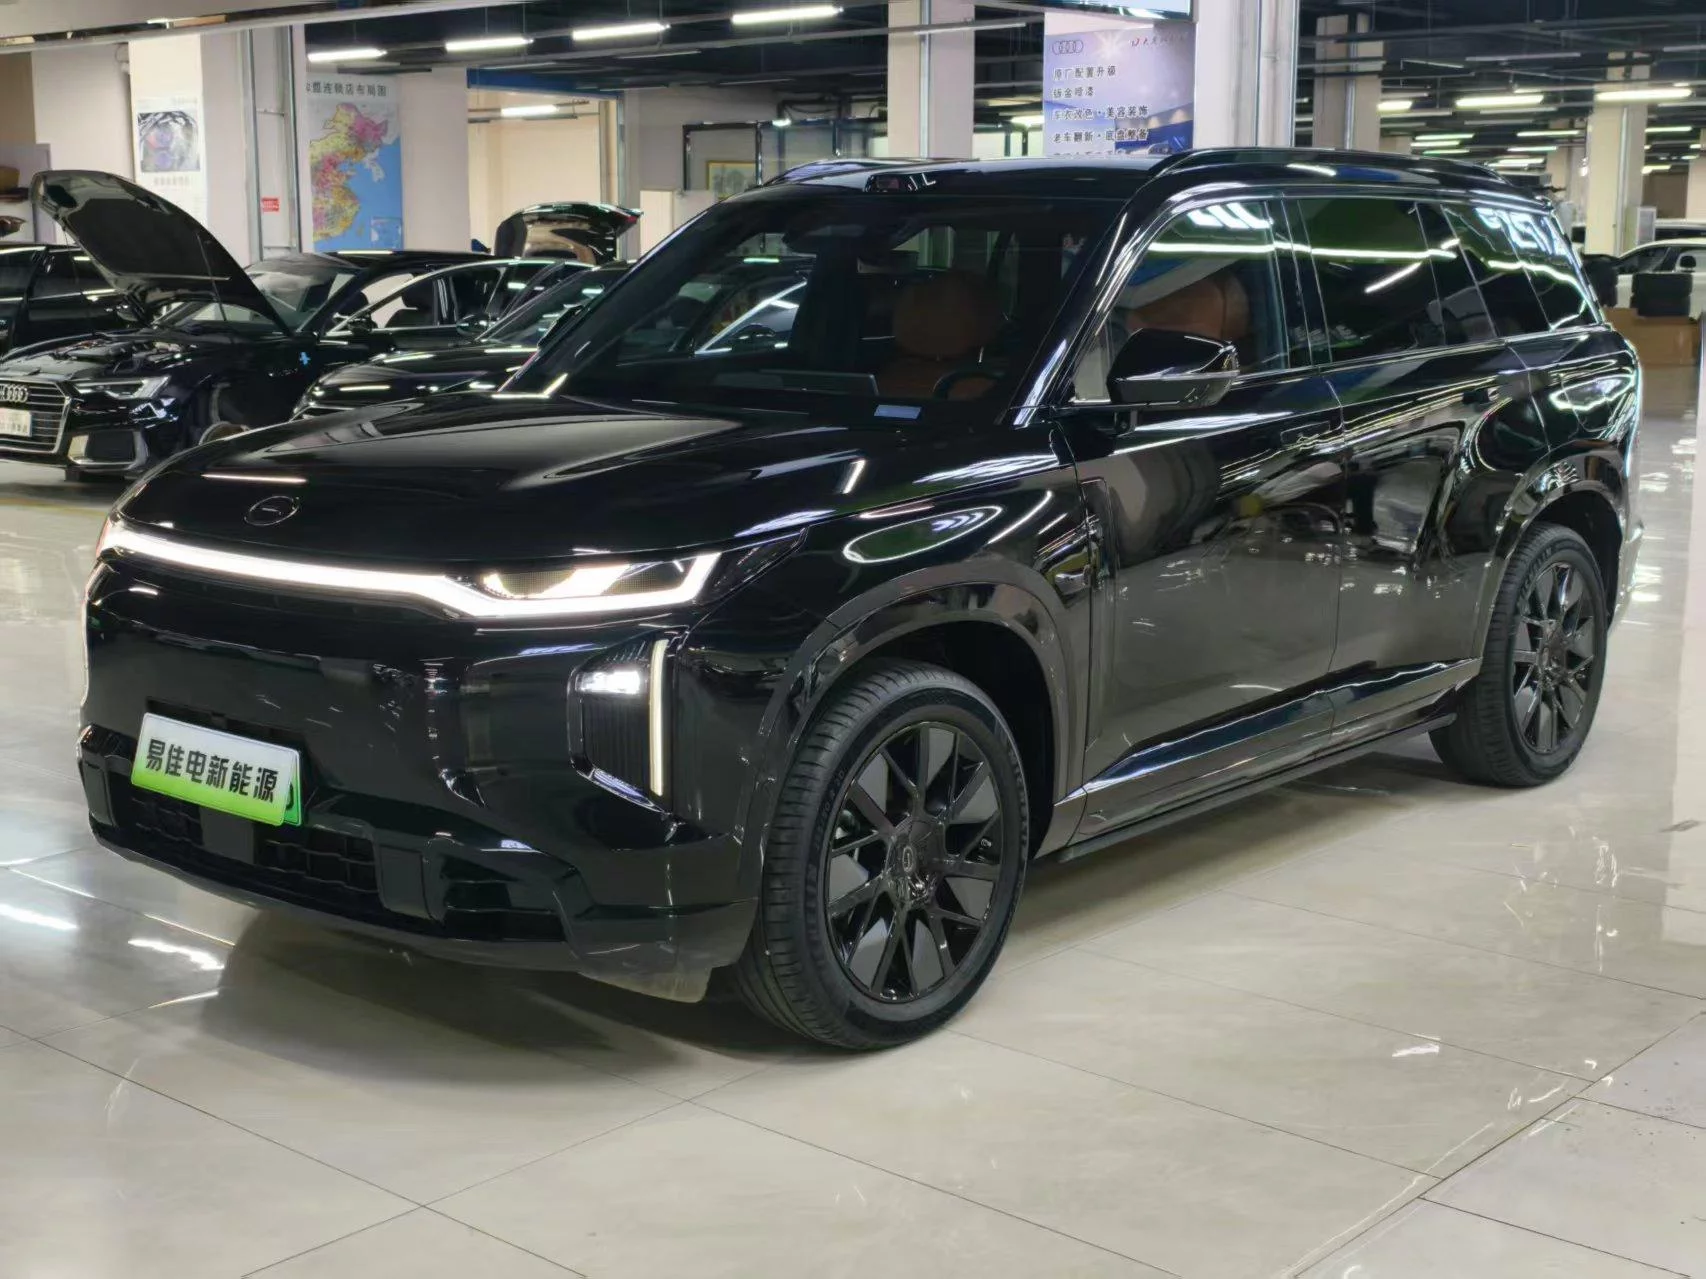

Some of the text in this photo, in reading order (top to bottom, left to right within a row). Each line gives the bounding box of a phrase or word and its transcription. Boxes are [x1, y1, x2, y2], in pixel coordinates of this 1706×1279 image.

[145, 738, 279, 804] 易佳电新能源
